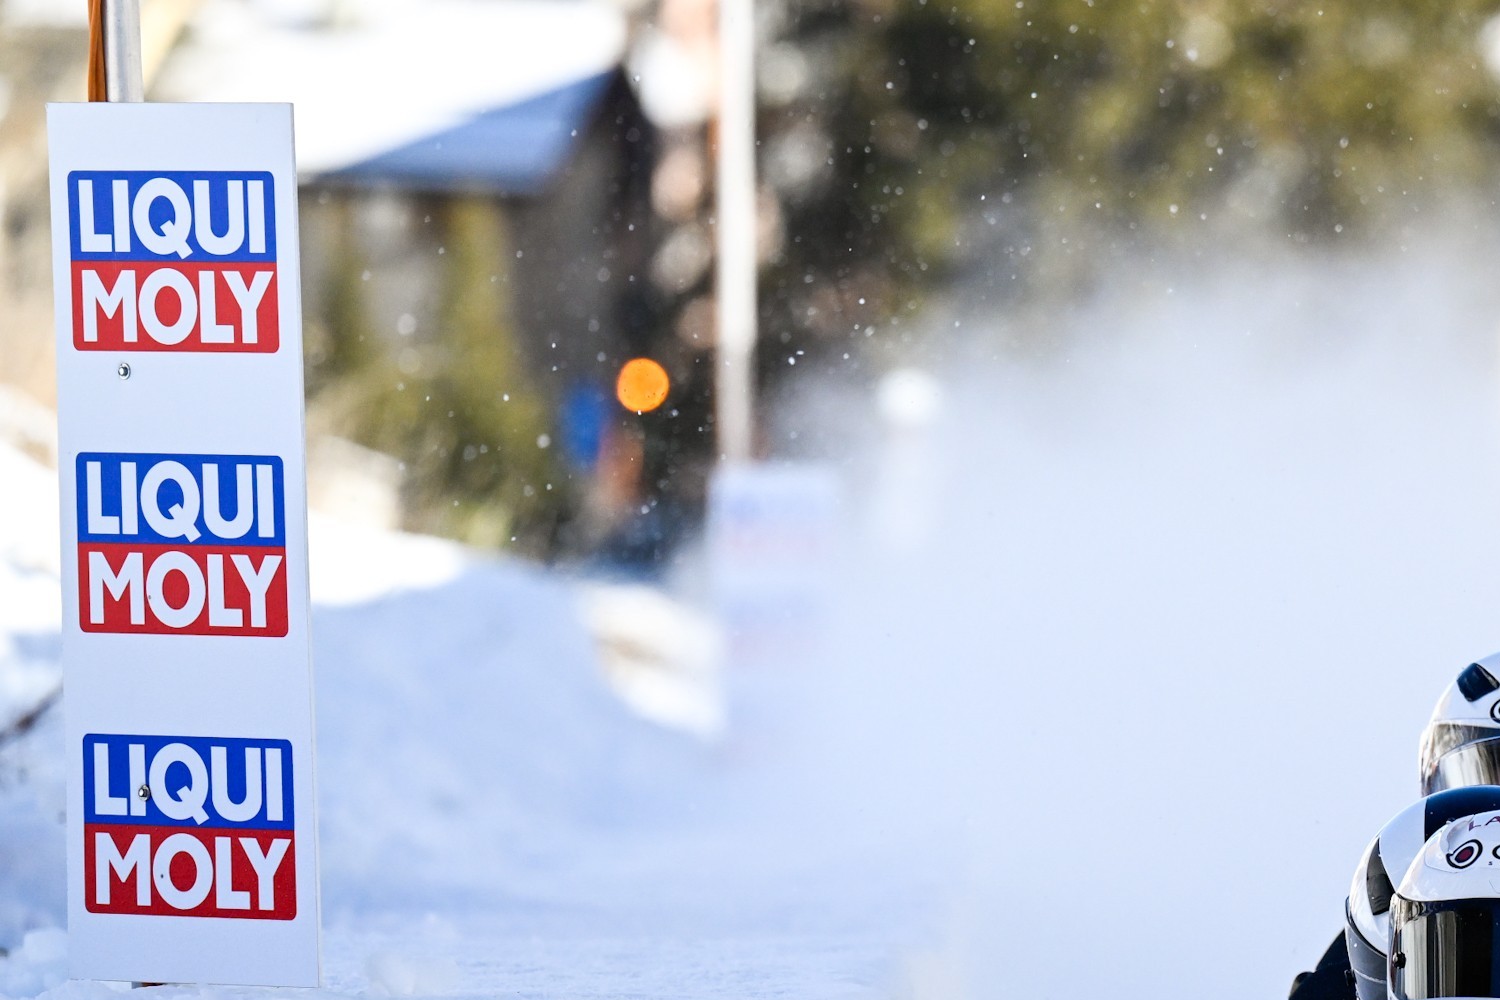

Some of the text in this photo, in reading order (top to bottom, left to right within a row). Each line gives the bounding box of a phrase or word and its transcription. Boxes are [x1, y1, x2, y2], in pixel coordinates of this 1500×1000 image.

[77, 177, 267, 260] LIQUI
[81, 267, 275, 346] MOLY
[86, 460, 275, 543] LIQUI
[88, 550, 283, 629] MOLY
[93, 742, 284, 826] LIQUI
[94, 832, 292, 911] MOLY
